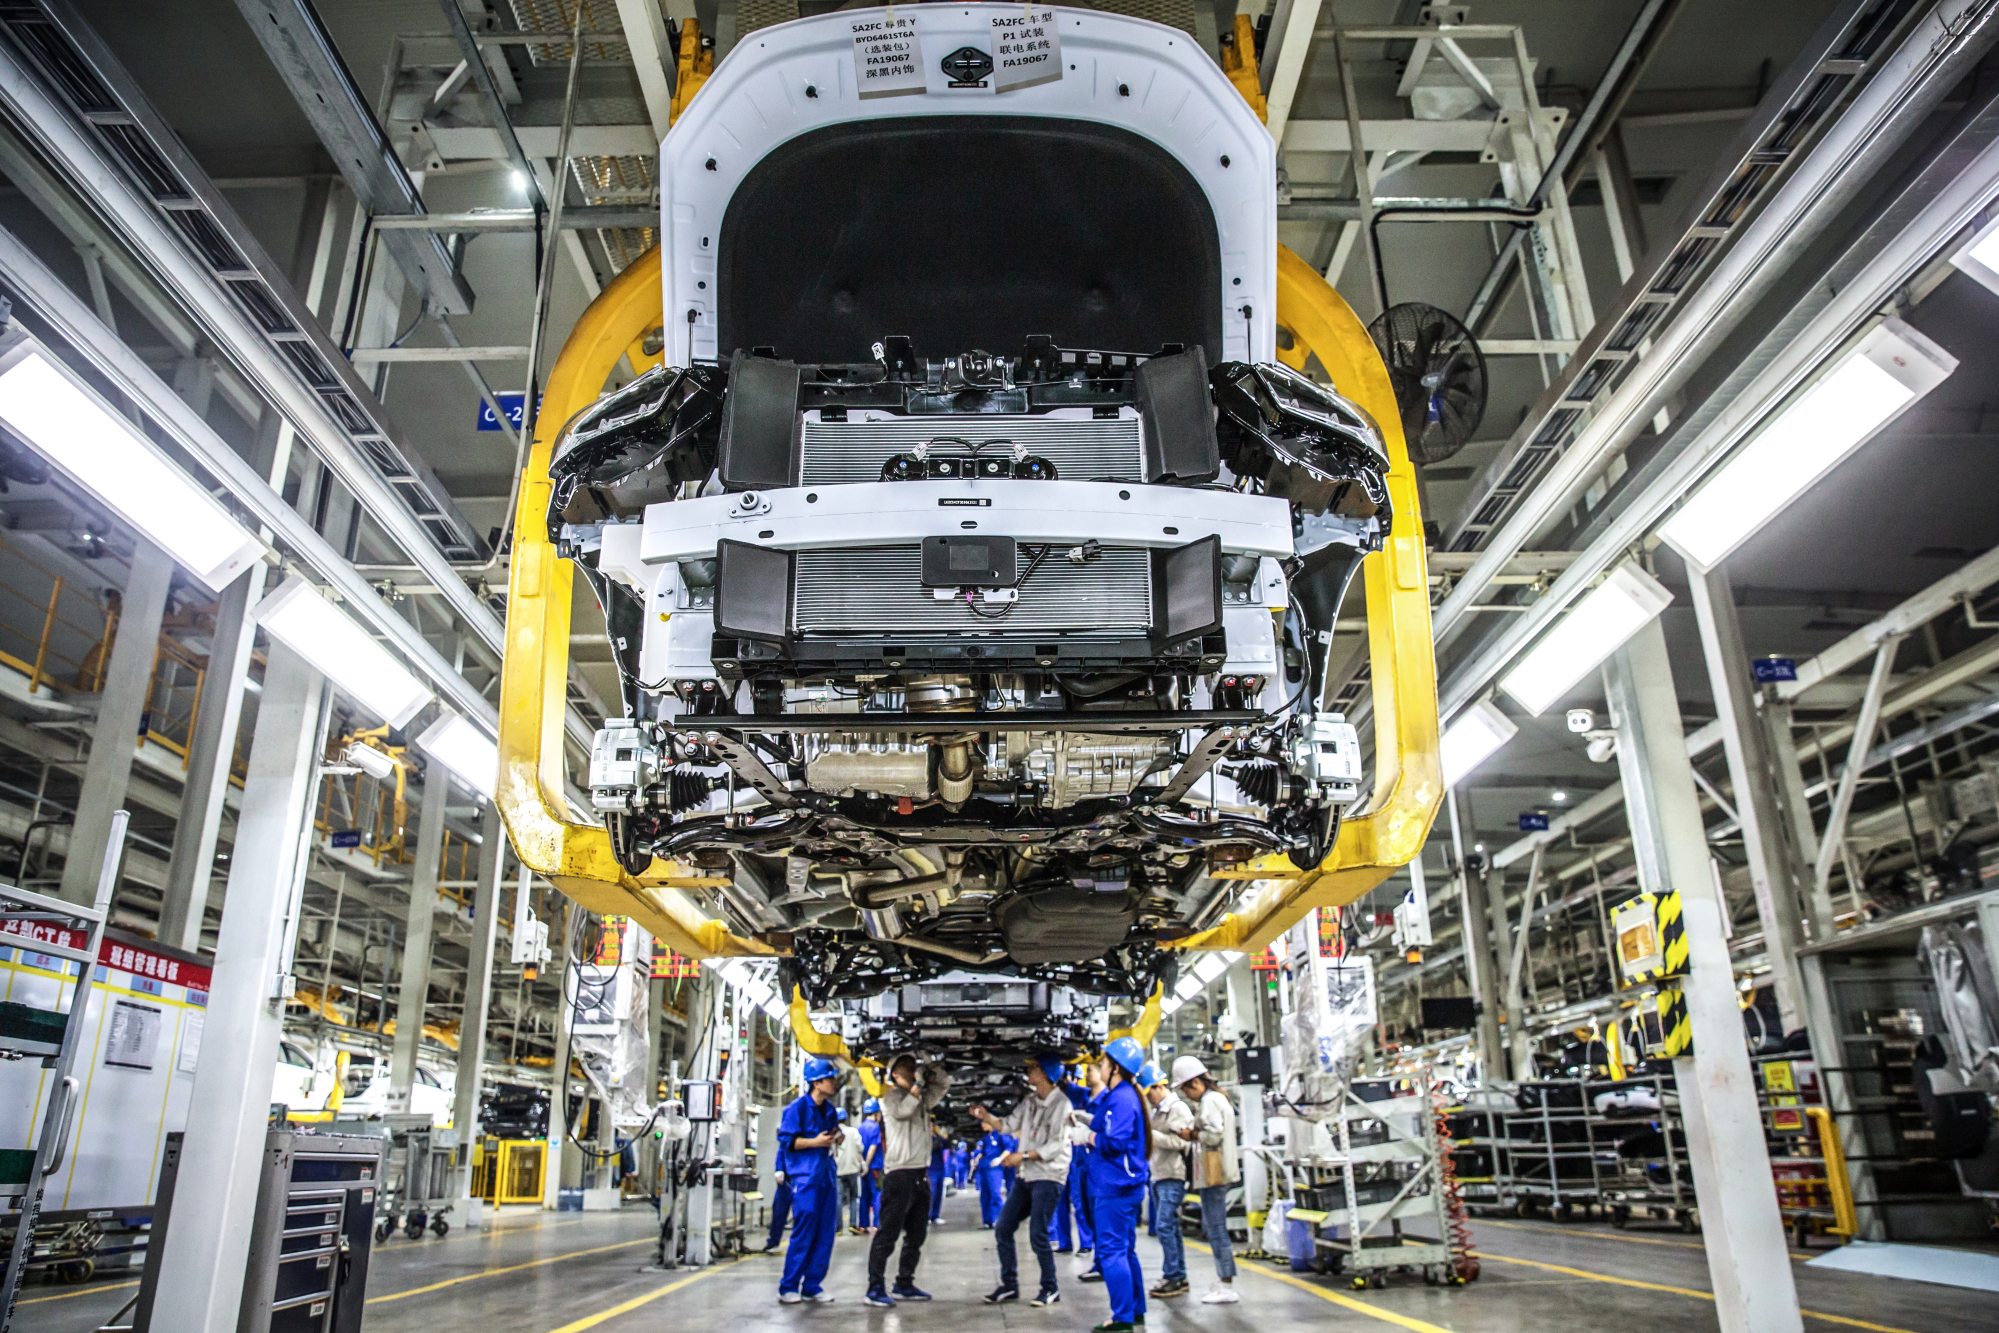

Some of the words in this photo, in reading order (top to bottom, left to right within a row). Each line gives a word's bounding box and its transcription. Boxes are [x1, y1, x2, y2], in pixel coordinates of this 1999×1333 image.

[852, 23, 882, 33] SA2FC
[909, 18, 916, 26] Y
[992, 17, 1025, 27] SA2FC
[1029, 11, 1053, 24] 车型
[1003, 32, 1016, 41] P1
[1020, 27, 1045, 39] 试装
[999, 40, 1051, 55] 联电系统
[867, 53, 910, 65] FA19067
[1003, 53, 1048, 68] FA19067
[866, 64, 915, 79] 深黑内饰
